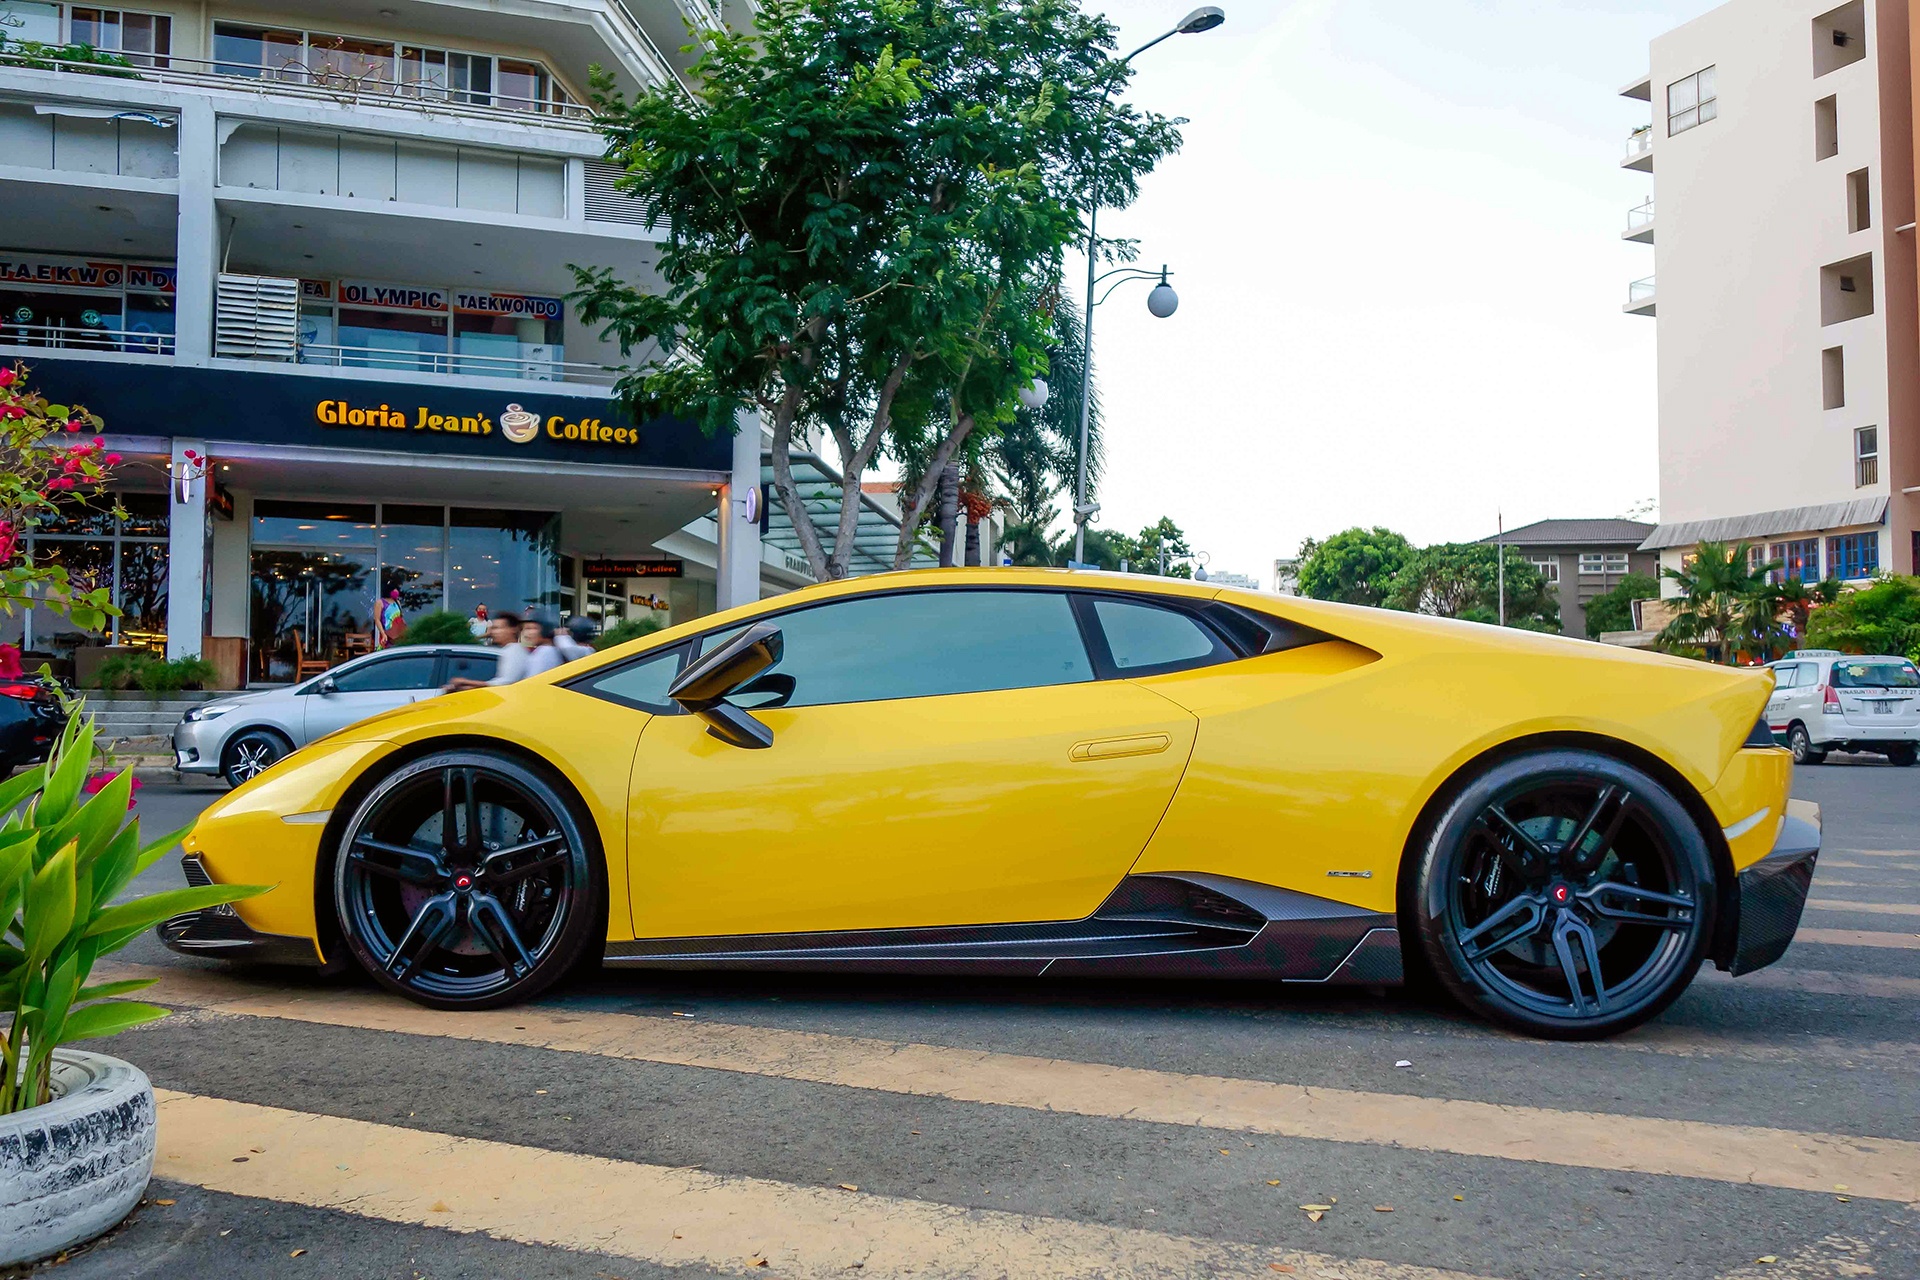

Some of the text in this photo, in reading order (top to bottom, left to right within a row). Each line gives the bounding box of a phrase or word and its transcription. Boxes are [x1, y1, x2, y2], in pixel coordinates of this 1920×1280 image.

[0, 262, 177, 288] TAEKWOND
[345, 284, 442, 309] OLYMPIC
[457, 294, 558, 316] TAEKWONDO
[316, 400, 640, 444] Gloria Jean's Coffees
